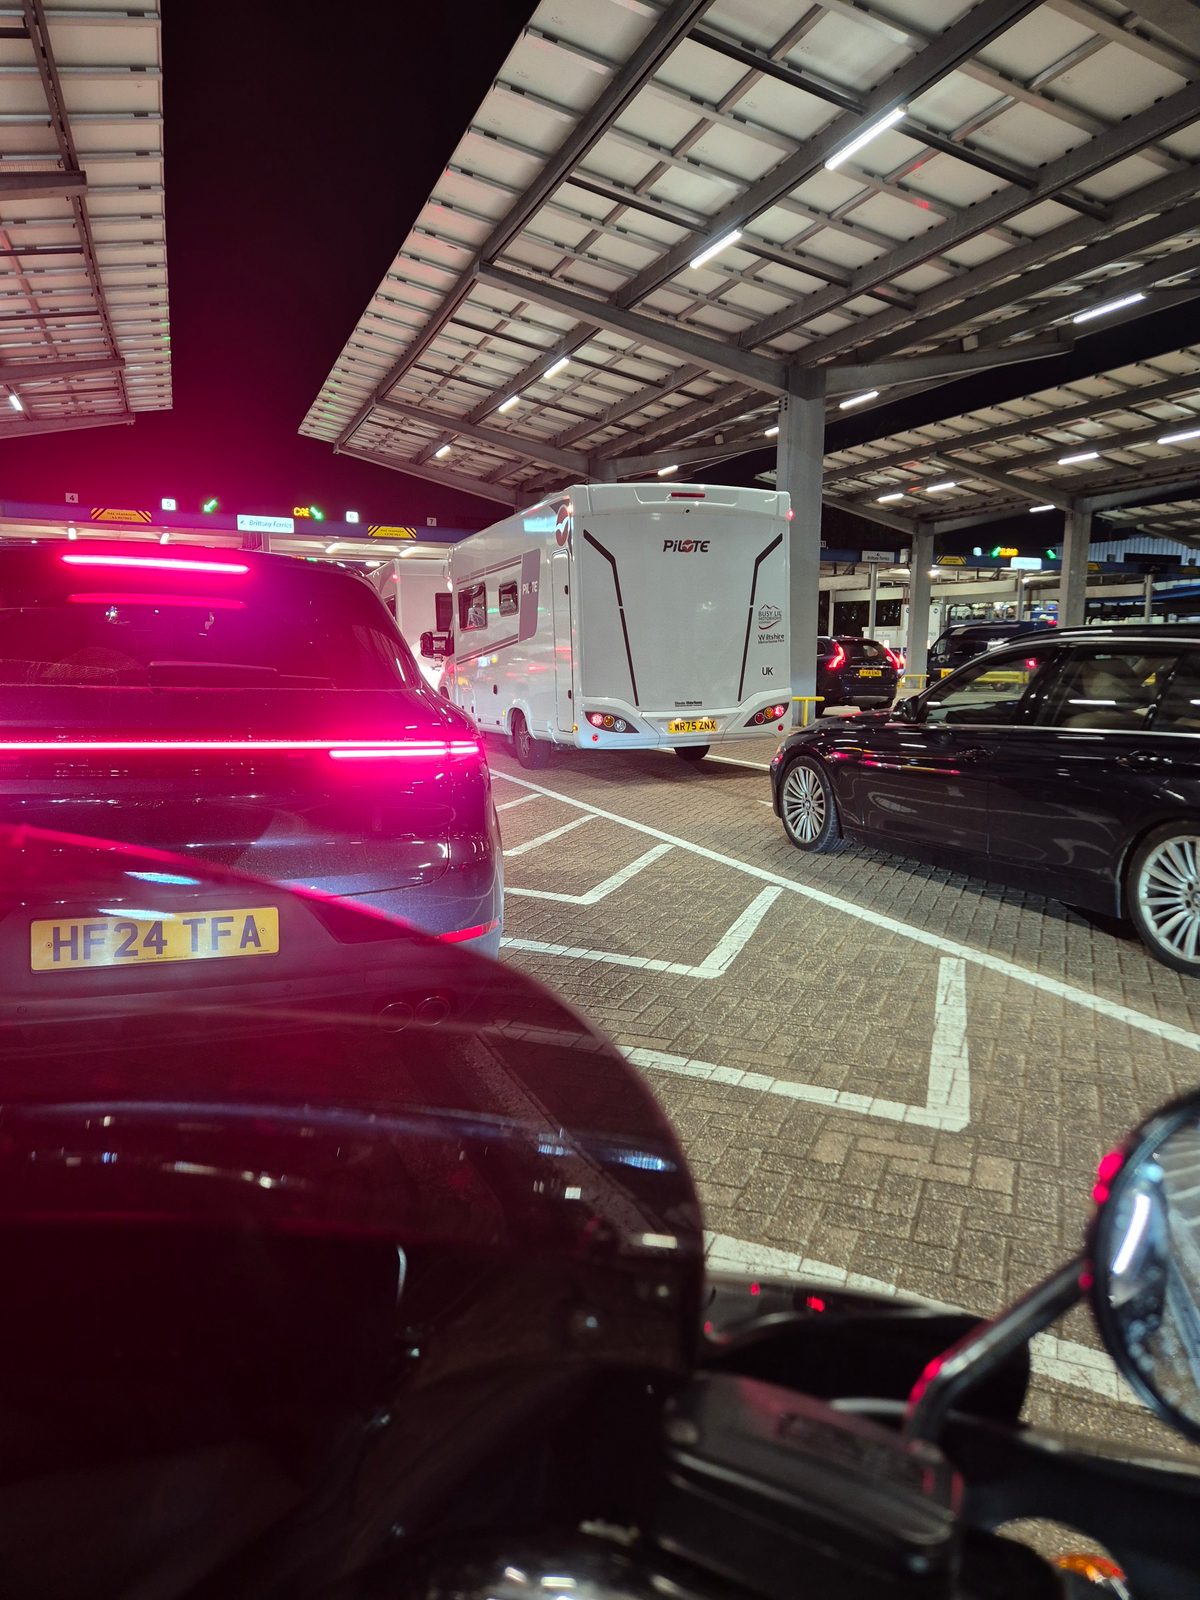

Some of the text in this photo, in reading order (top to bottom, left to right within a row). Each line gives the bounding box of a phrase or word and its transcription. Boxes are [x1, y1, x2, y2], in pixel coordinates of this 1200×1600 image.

[249, 519, 272, 528] Brittany
[758, 633, 785, 641] Wiltshire
[761, 666, 774, 676] UK
[699, 720, 716, 730] ZNX
[52, 914, 262, 962] HF24 TFA
